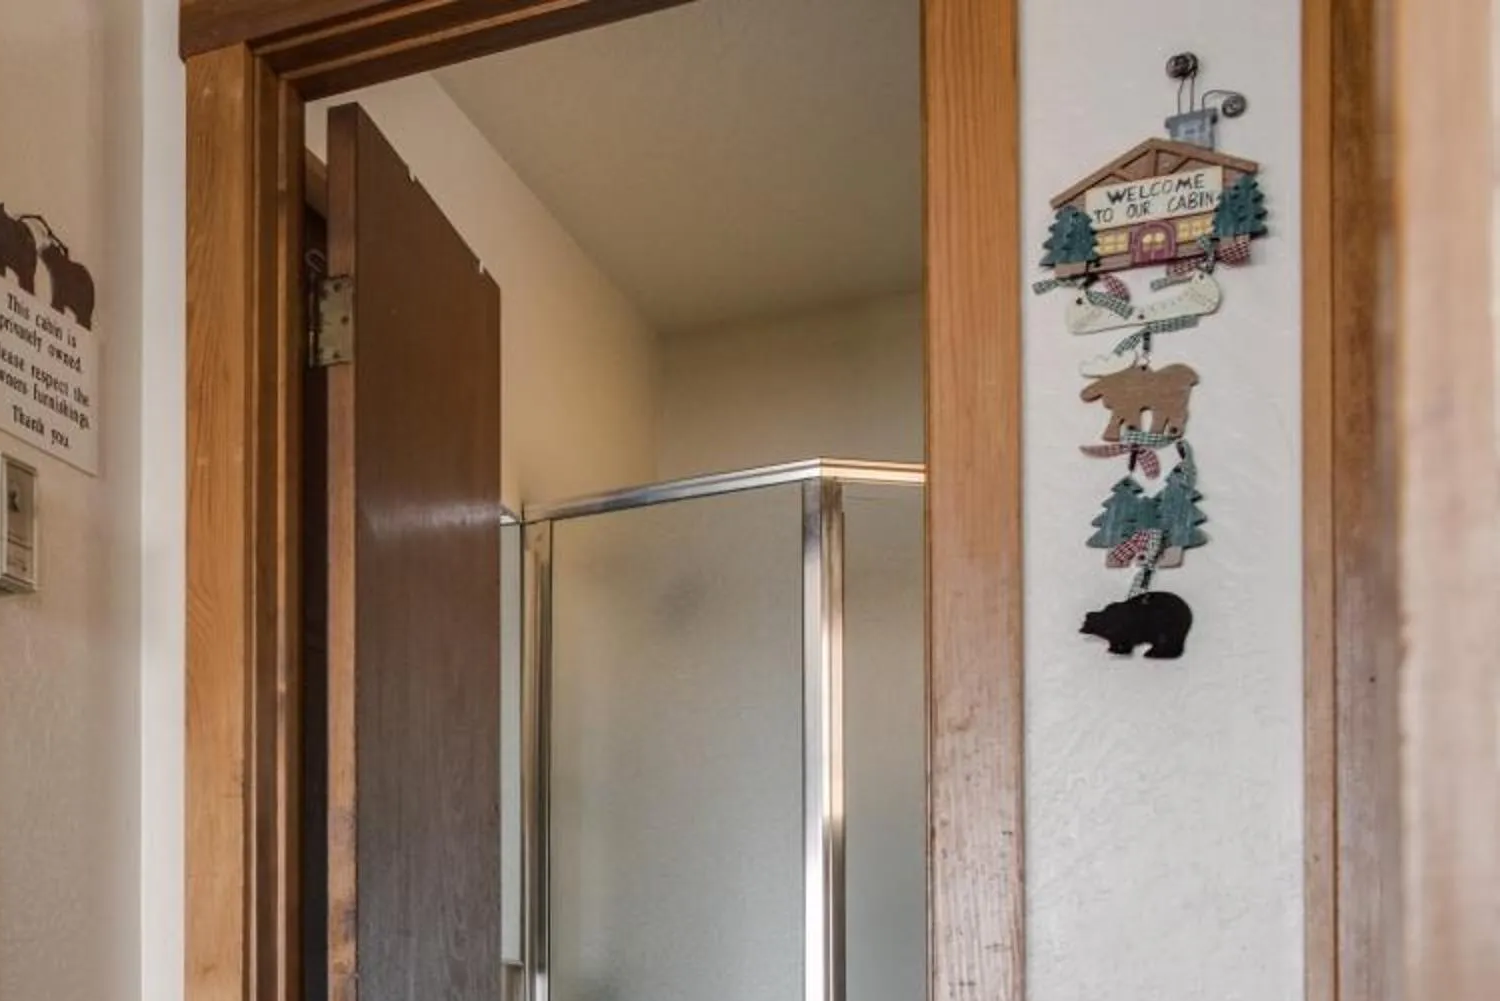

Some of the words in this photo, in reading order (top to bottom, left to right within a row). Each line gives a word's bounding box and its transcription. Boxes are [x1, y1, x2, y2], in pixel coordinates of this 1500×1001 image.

[1107, 174, 1204, 204] WELCOME
[1094, 207, 1113, 222] TO
[1126, 201, 1150, 219] OUR
[1167, 191, 1213, 212] CABIN
[7, 293, 29, 320] This
[36, 314, 62, 341] cabin
[67, 329, 77, 348] is
[32, 365, 69, 397] respect
[74, 387, 90, 407] the
[13, 405, 44, 435] Thank
